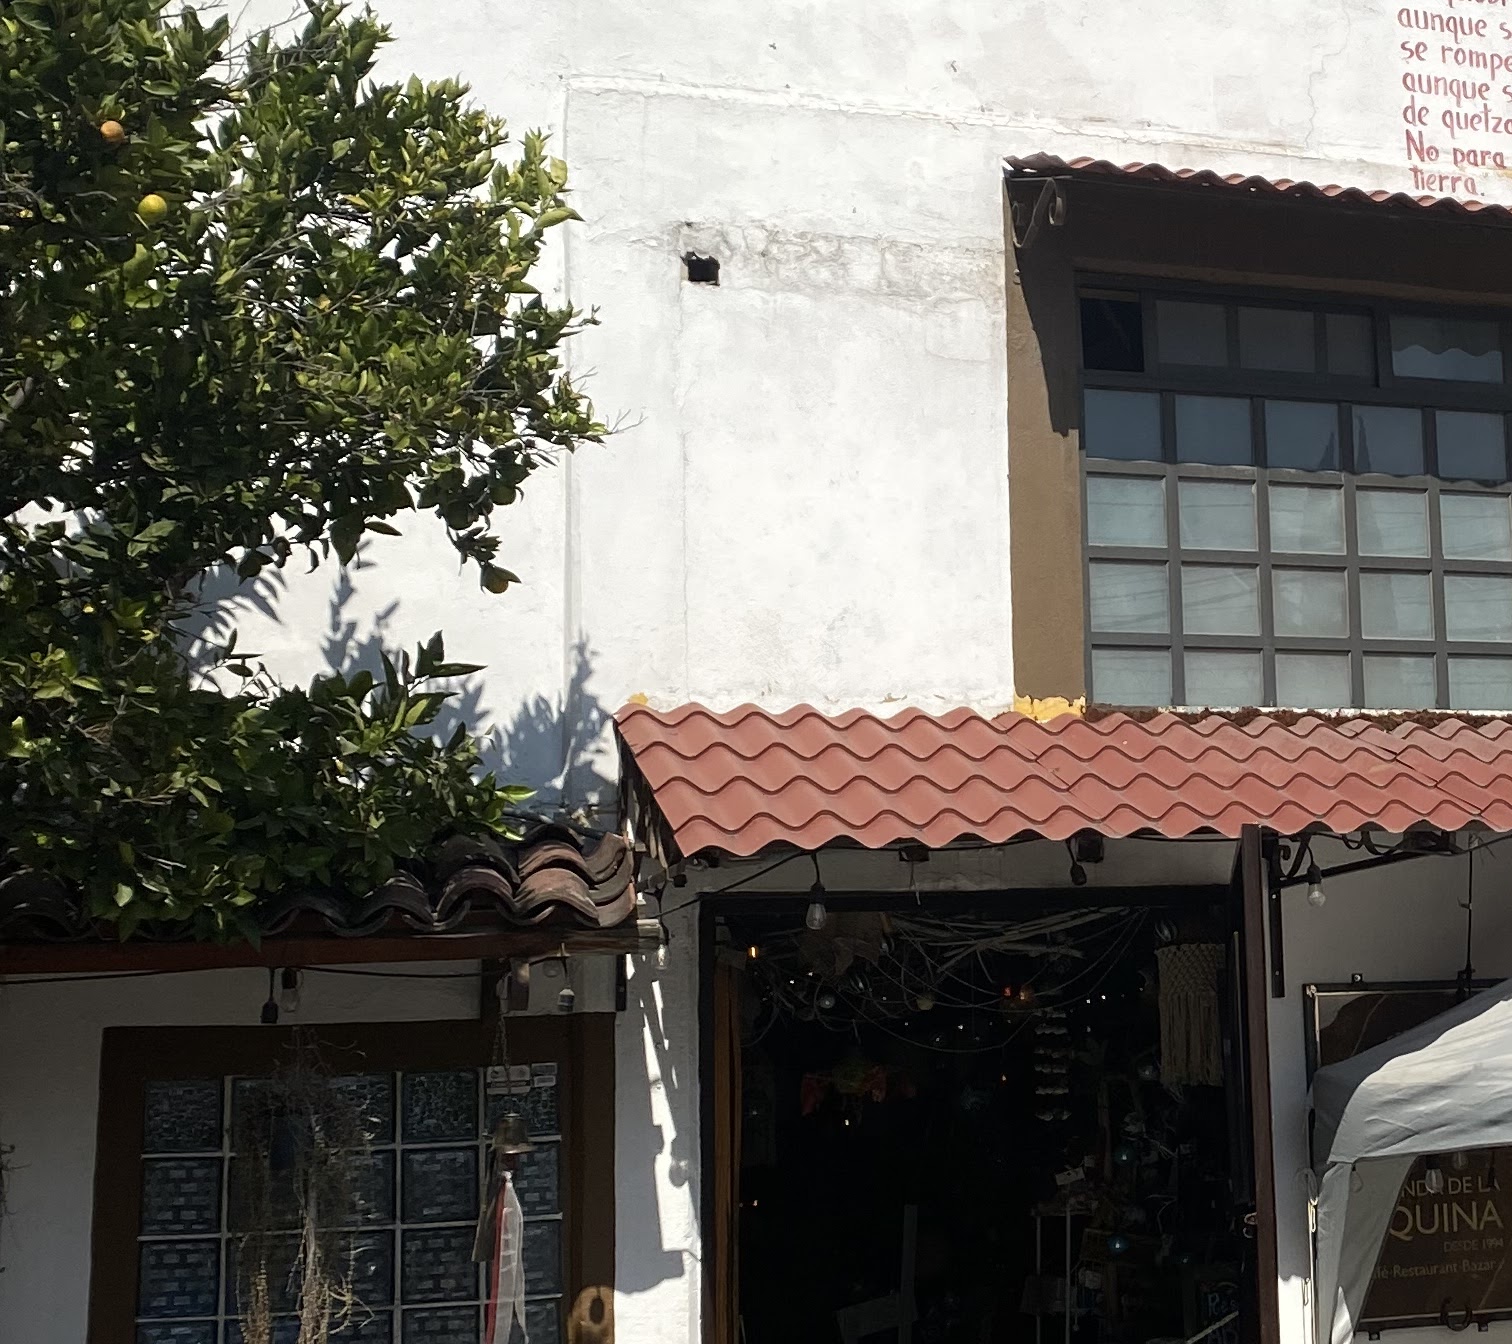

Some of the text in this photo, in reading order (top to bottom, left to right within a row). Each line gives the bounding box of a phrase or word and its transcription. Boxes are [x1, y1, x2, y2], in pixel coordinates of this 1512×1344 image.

[1397, 6, 1488, 44] aunque
[1400, 39, 1428, 63] se
[1402, 71, 1490, 108] aunque
[1402, 95, 1430, 127] de
[1405, 129, 1440, 163] No
[1452, 146, 1506, 170] para
[1409, 164, 1485, 196] tierra.
[1448, 1176, 1473, 1195] DE
